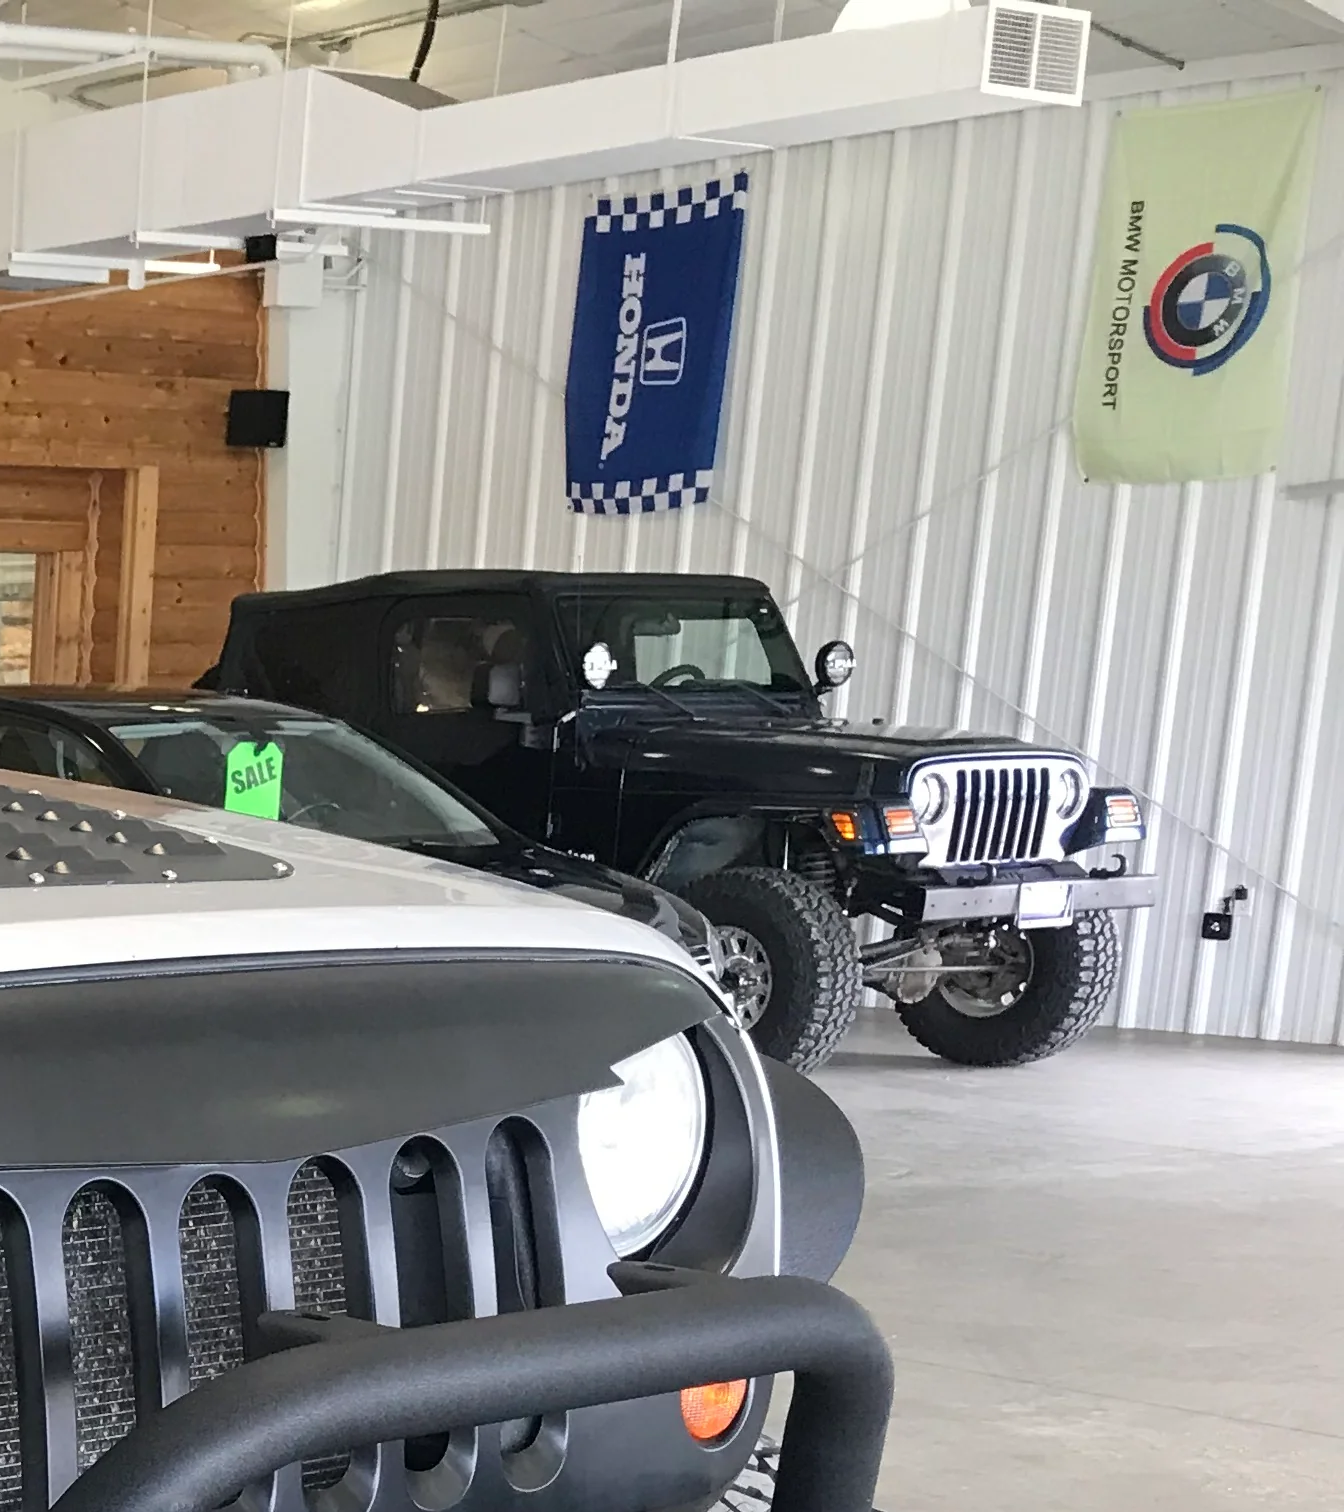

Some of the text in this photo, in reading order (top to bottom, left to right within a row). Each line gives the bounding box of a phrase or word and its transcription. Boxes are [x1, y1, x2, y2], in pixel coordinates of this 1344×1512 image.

[600, 252, 646, 461] HONDA
[1101, 200, 1145, 411] BMW MOTORSPORT
[231, 757, 277, 794] SALE
